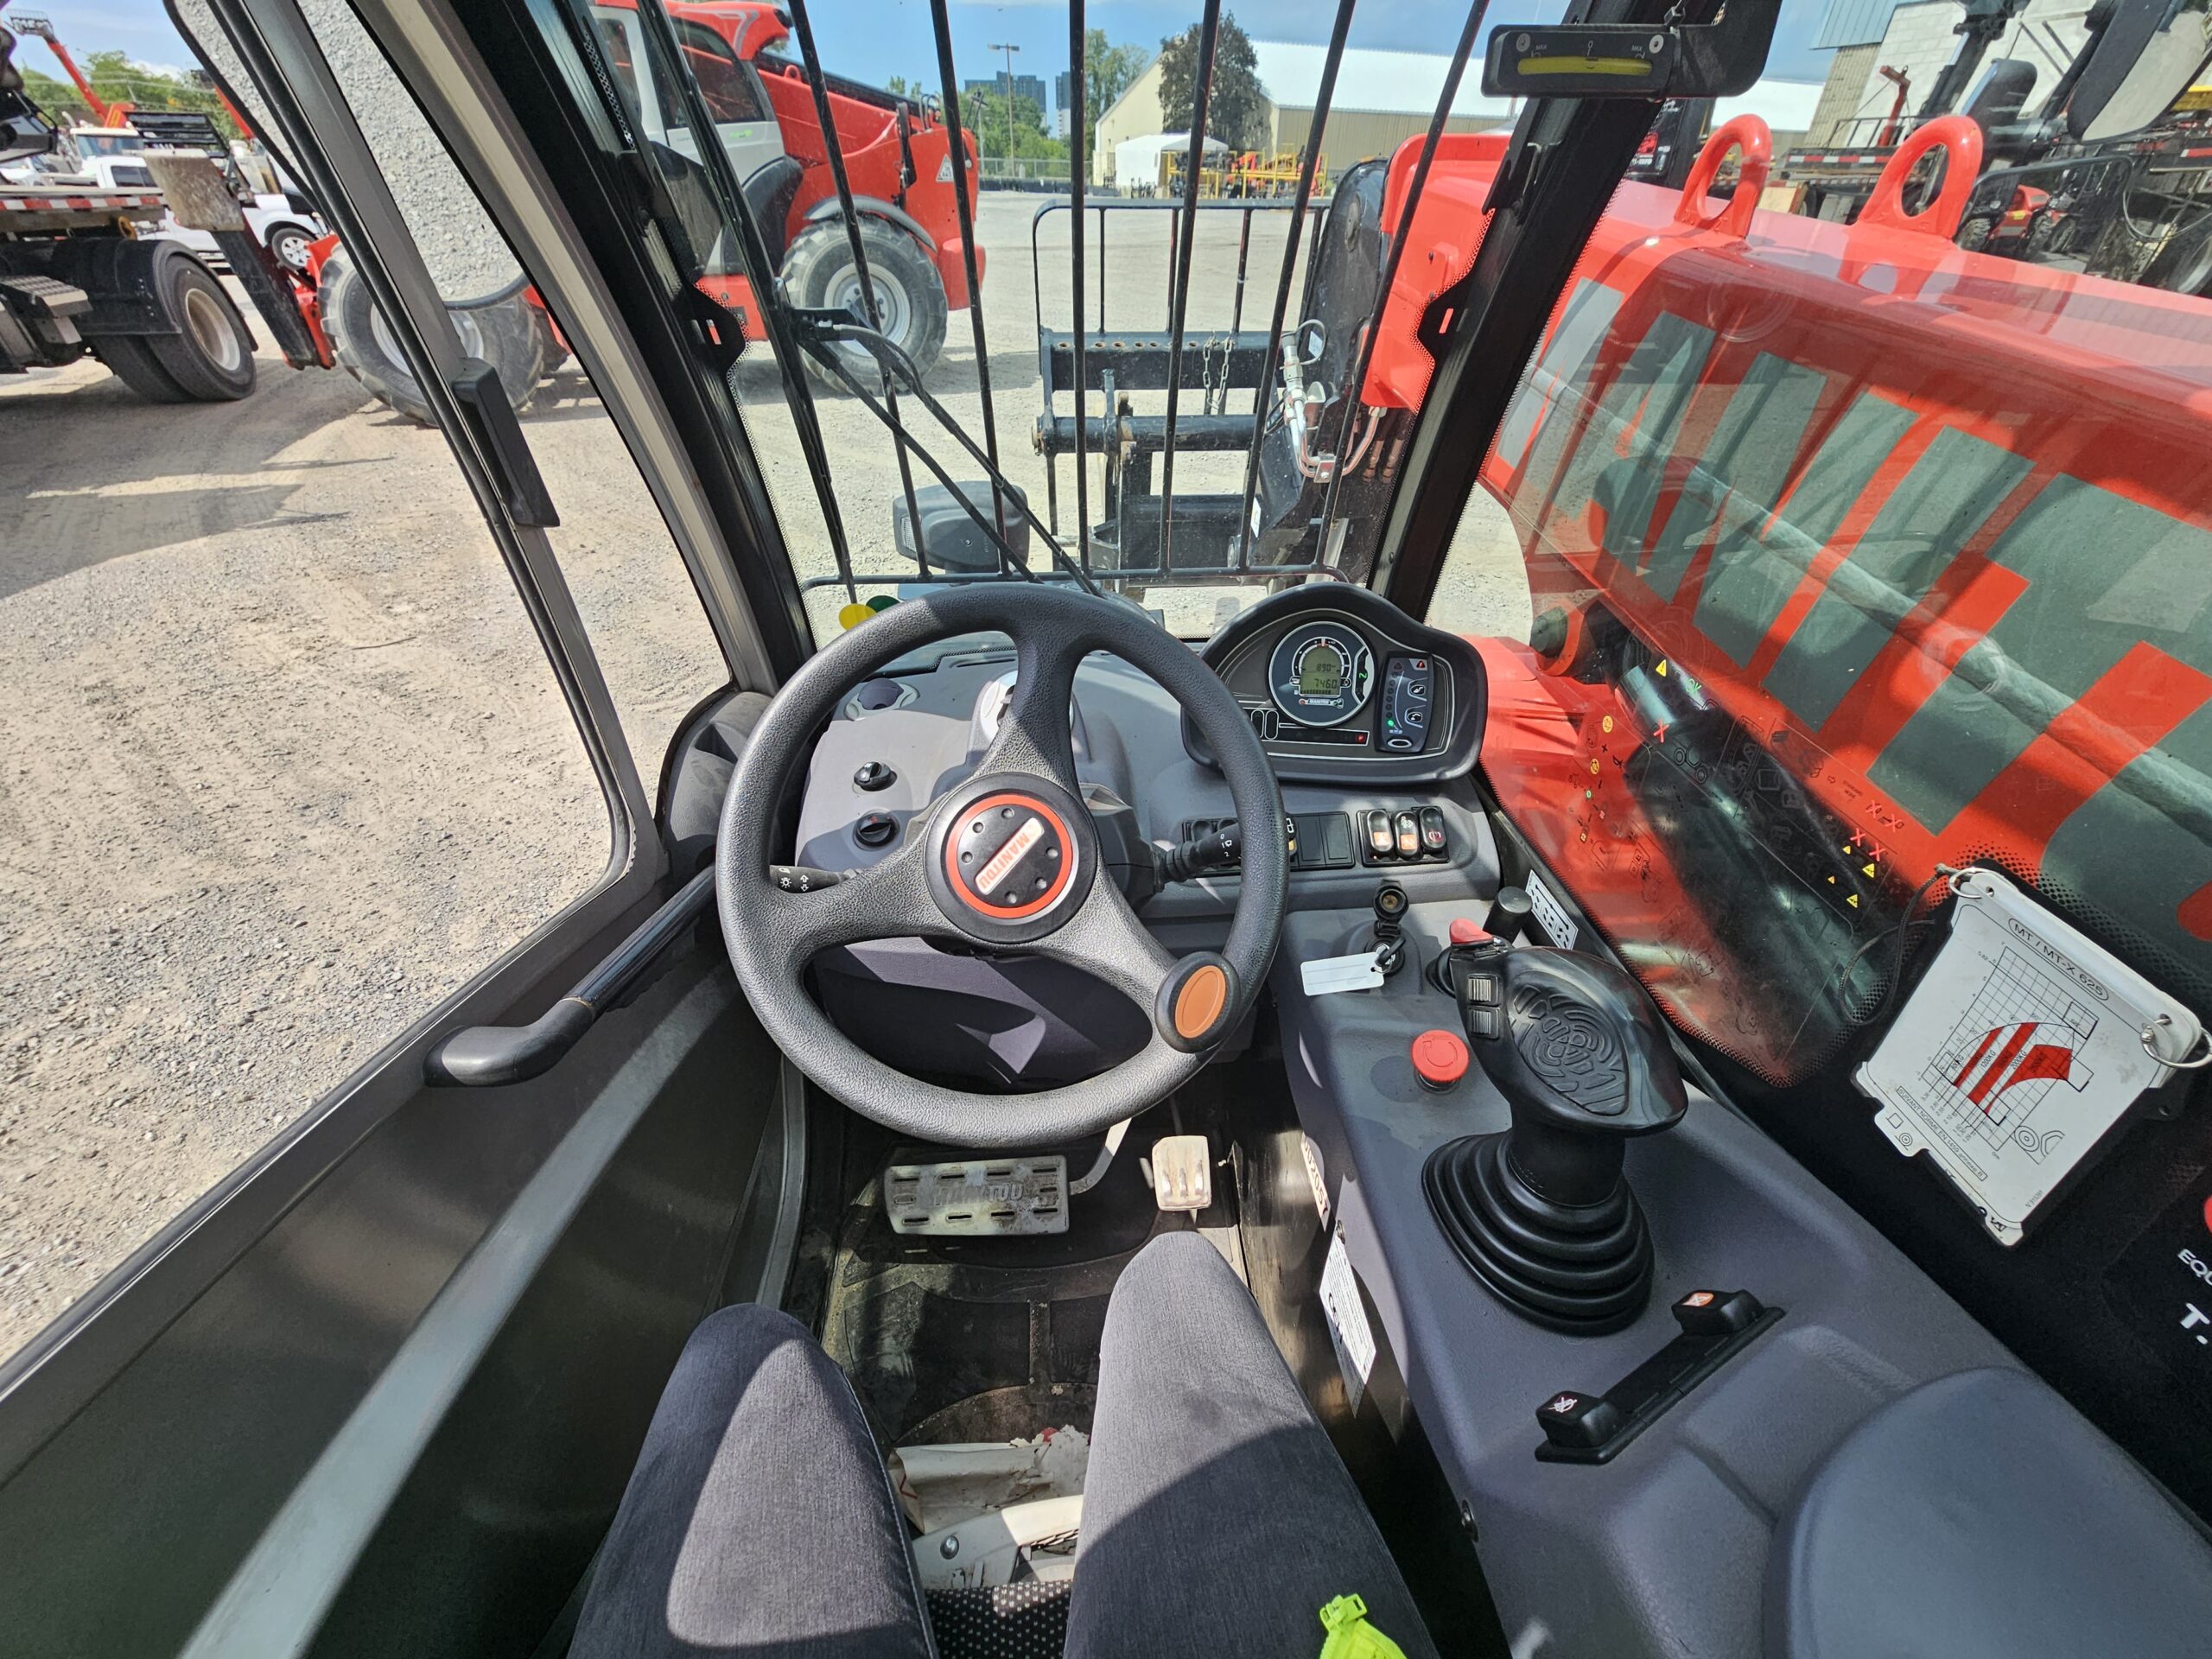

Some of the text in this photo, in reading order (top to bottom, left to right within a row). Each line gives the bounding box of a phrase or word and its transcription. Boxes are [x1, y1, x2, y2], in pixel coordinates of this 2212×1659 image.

[978, 833, 1031, 889] MANITOU
[2014, 924, 2034, 941] MT
[2044, 945, 2075, 976] MT-X
[2079, 974, 2103, 996] 625
[1980, 1049, 1996, 1068] 1200KG
[1937, 1130, 1948, 1141] EN
